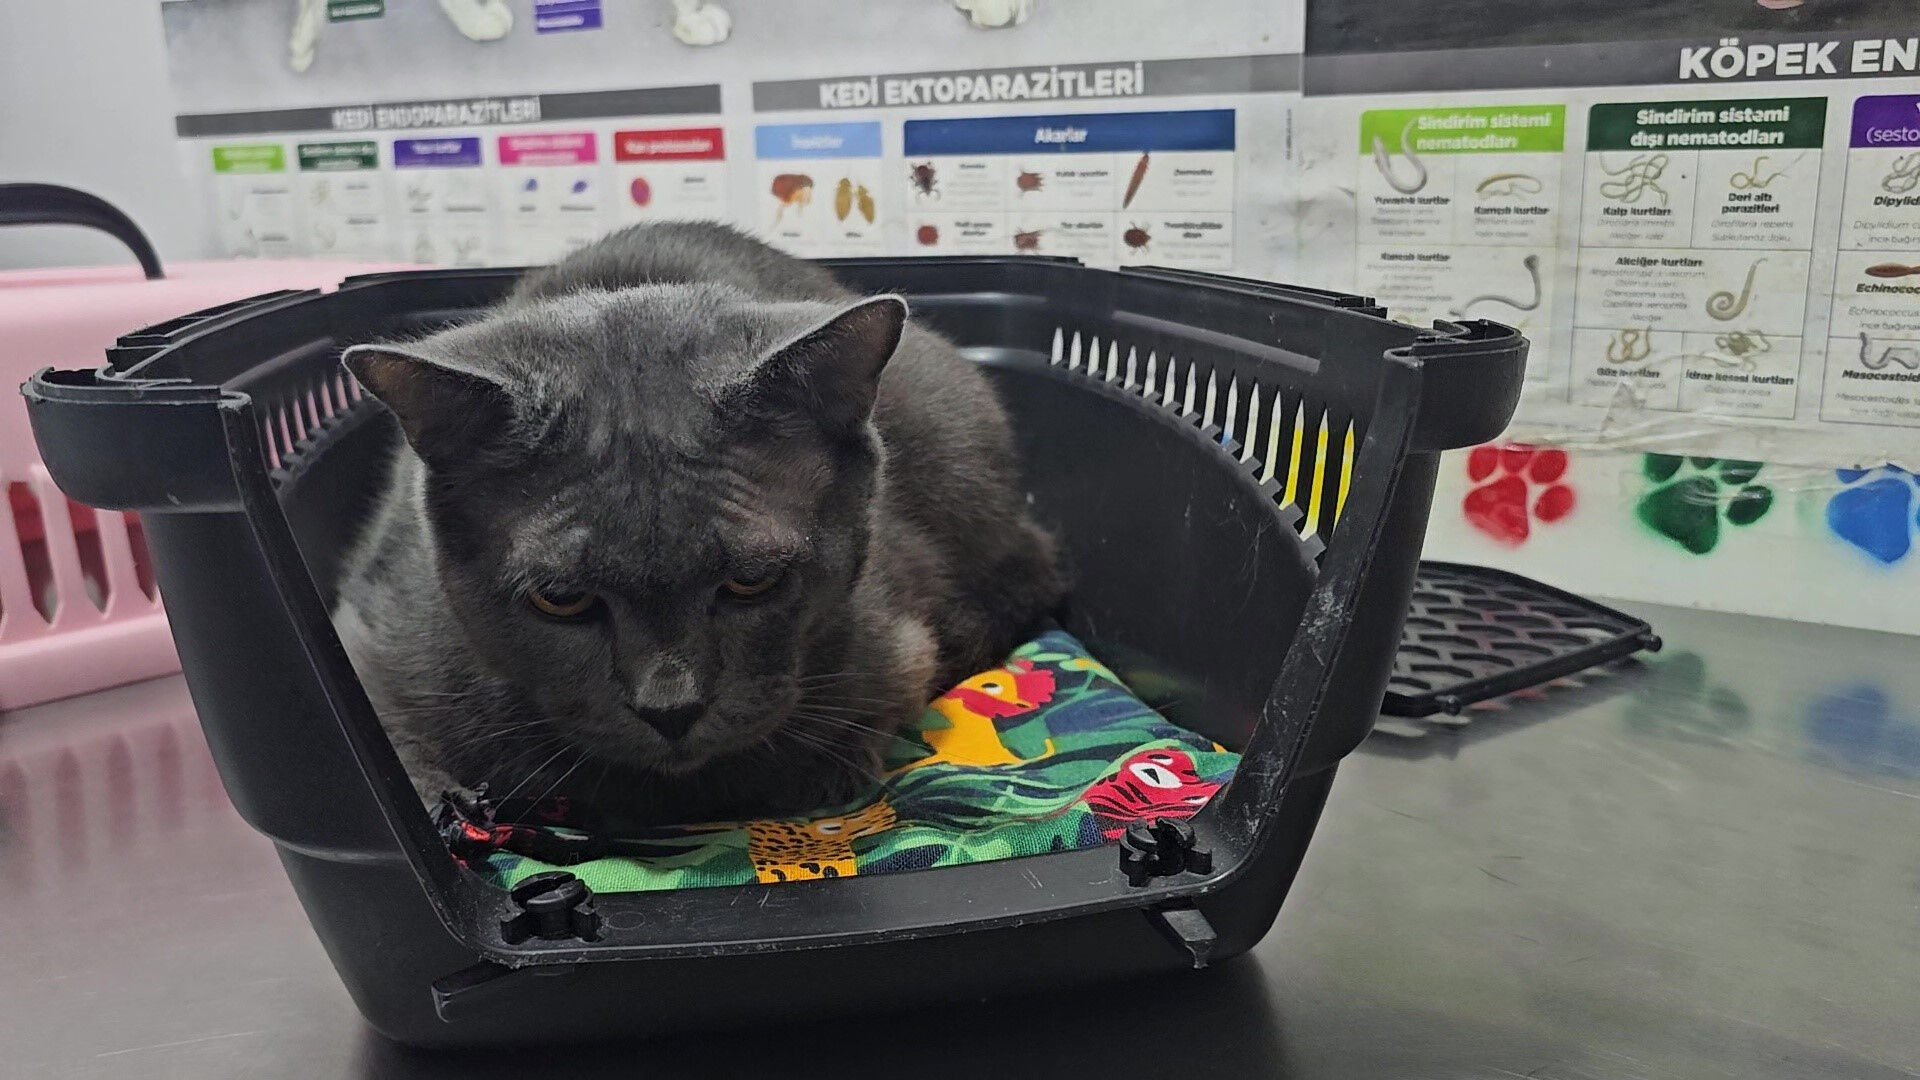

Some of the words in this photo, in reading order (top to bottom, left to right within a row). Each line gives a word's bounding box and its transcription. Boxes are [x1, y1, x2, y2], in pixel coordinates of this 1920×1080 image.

[1679, 37, 1840, 79] KÖPEK
[1851, 38, 1919, 73] EN
[819, 77, 878, 108] KEDİ
[884, 61, 1144, 105] EKTOPARAZİTLERİ
[1417, 113, 1487, 130] Sindirim
[1490, 112, 1552, 128] sistemi
[1636, 107, 1716, 125] Sindirim
[1718, 106, 1790, 123] sistemi
[1630, 131, 1665, 149] dışı
[1667, 129, 1785, 146] nematodları
[1866, 126, 1920, 144] (sesto
[1728, 192, 1752, 202] Deri
[1754, 193, 1773, 202] altı
[1602, 206, 1628, 217] Kalp
[1721, 204, 1780, 214] parazitleri
[1615, 256, 1659, 267] Akciğer
